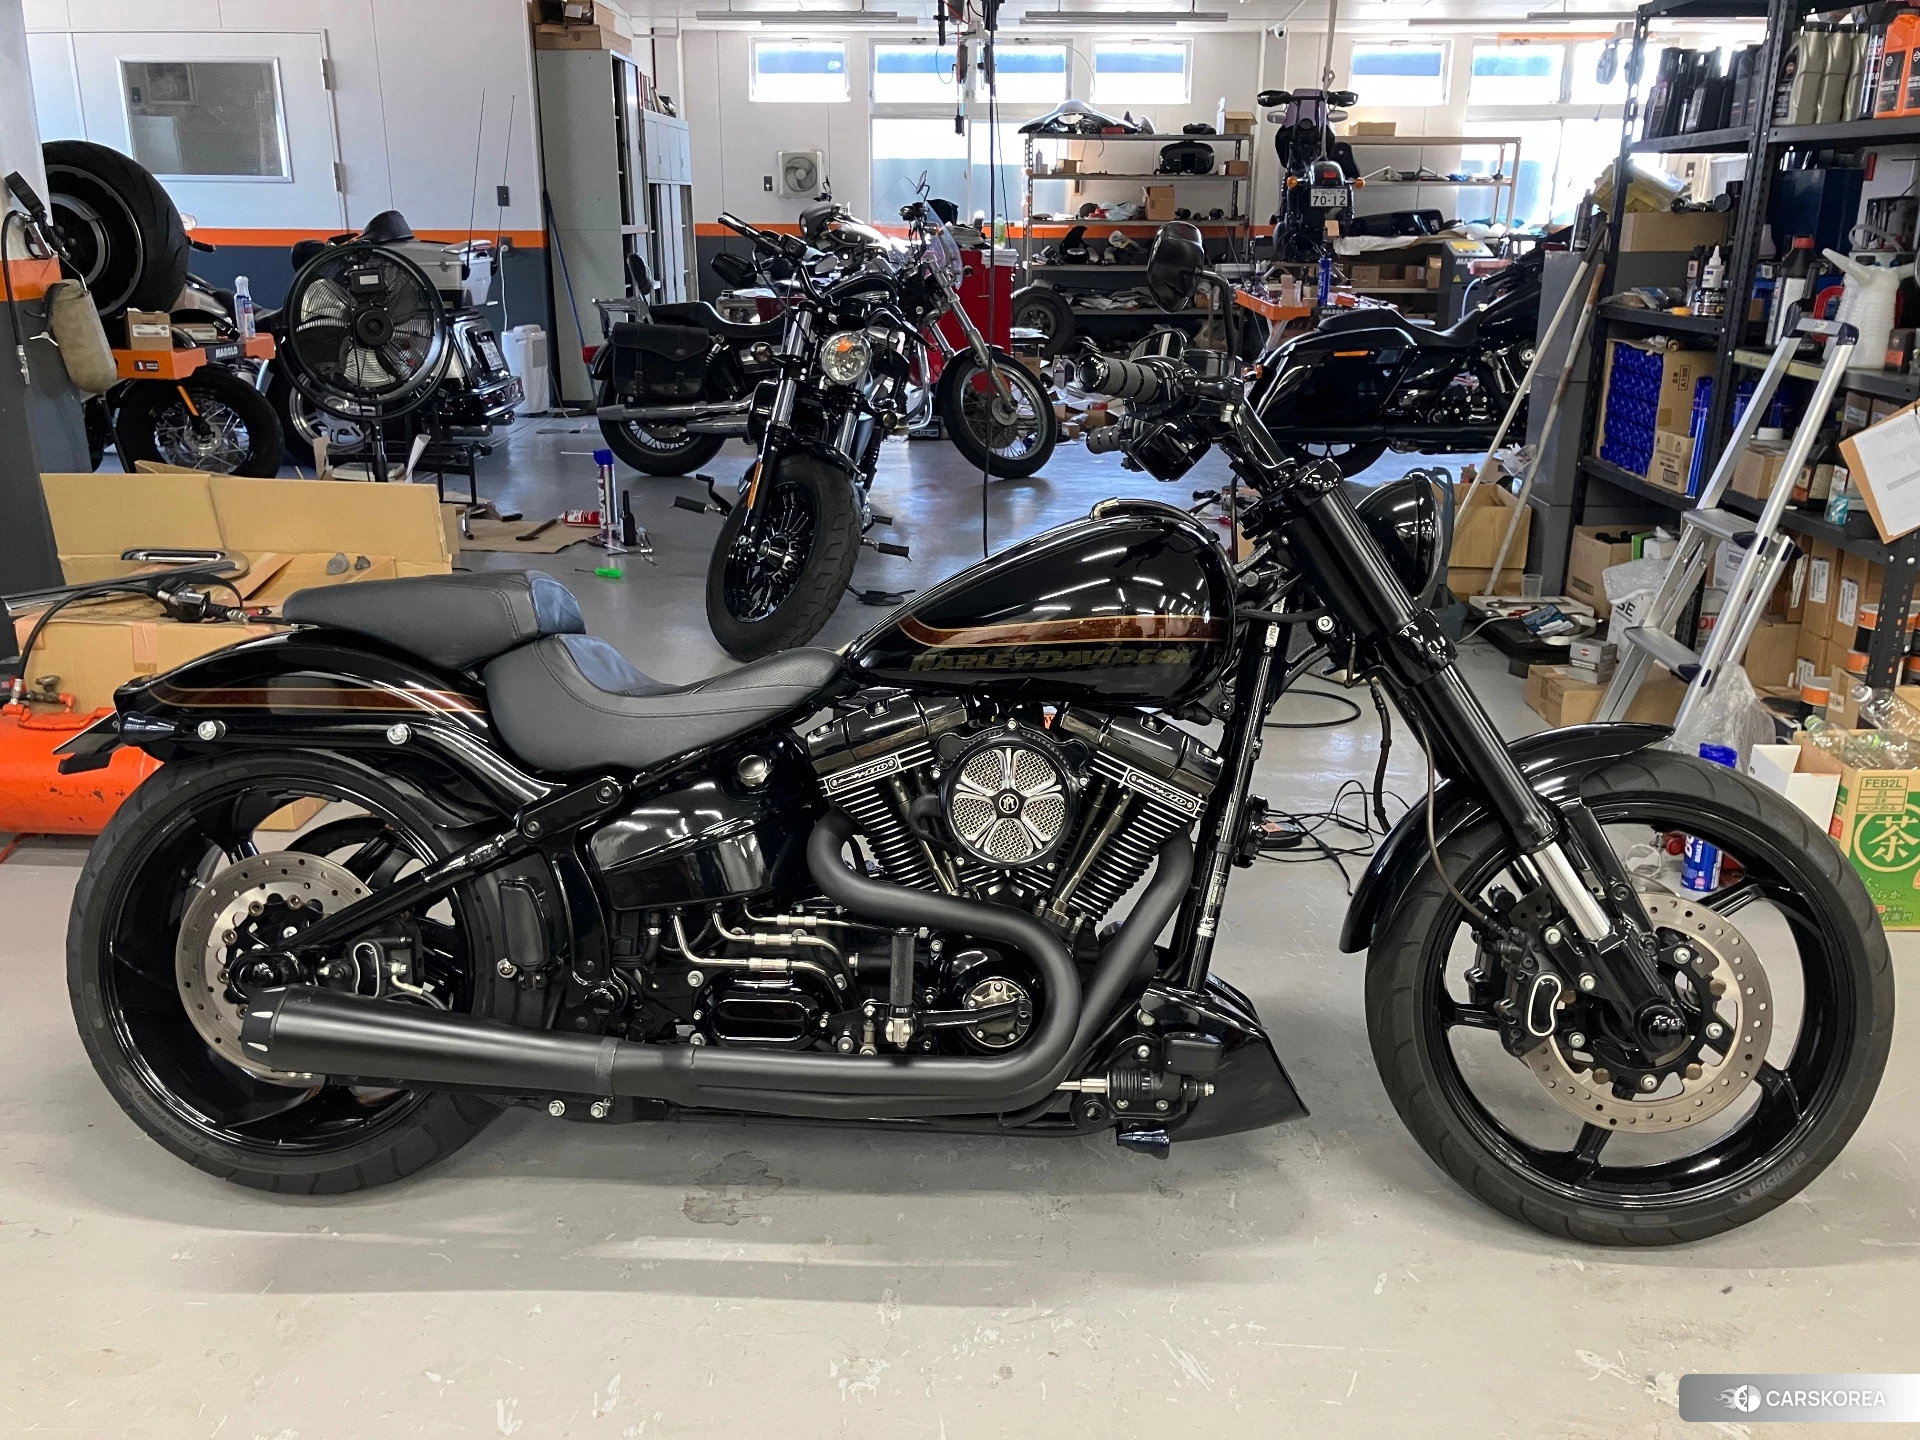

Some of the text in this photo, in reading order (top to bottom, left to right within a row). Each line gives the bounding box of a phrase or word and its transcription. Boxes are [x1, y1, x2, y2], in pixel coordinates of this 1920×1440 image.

[1312, 195, 1346, 206] 70-12
[215, 345, 238, 358] MAROLO
[909, 645, 1195, 672] HARLEY-DAVIDSON
[1865, 778, 1903, 788] FEB2L
[1868, 815, 1920, 863] 茶
[1749, 1152, 1807, 1196] MICHELIN
